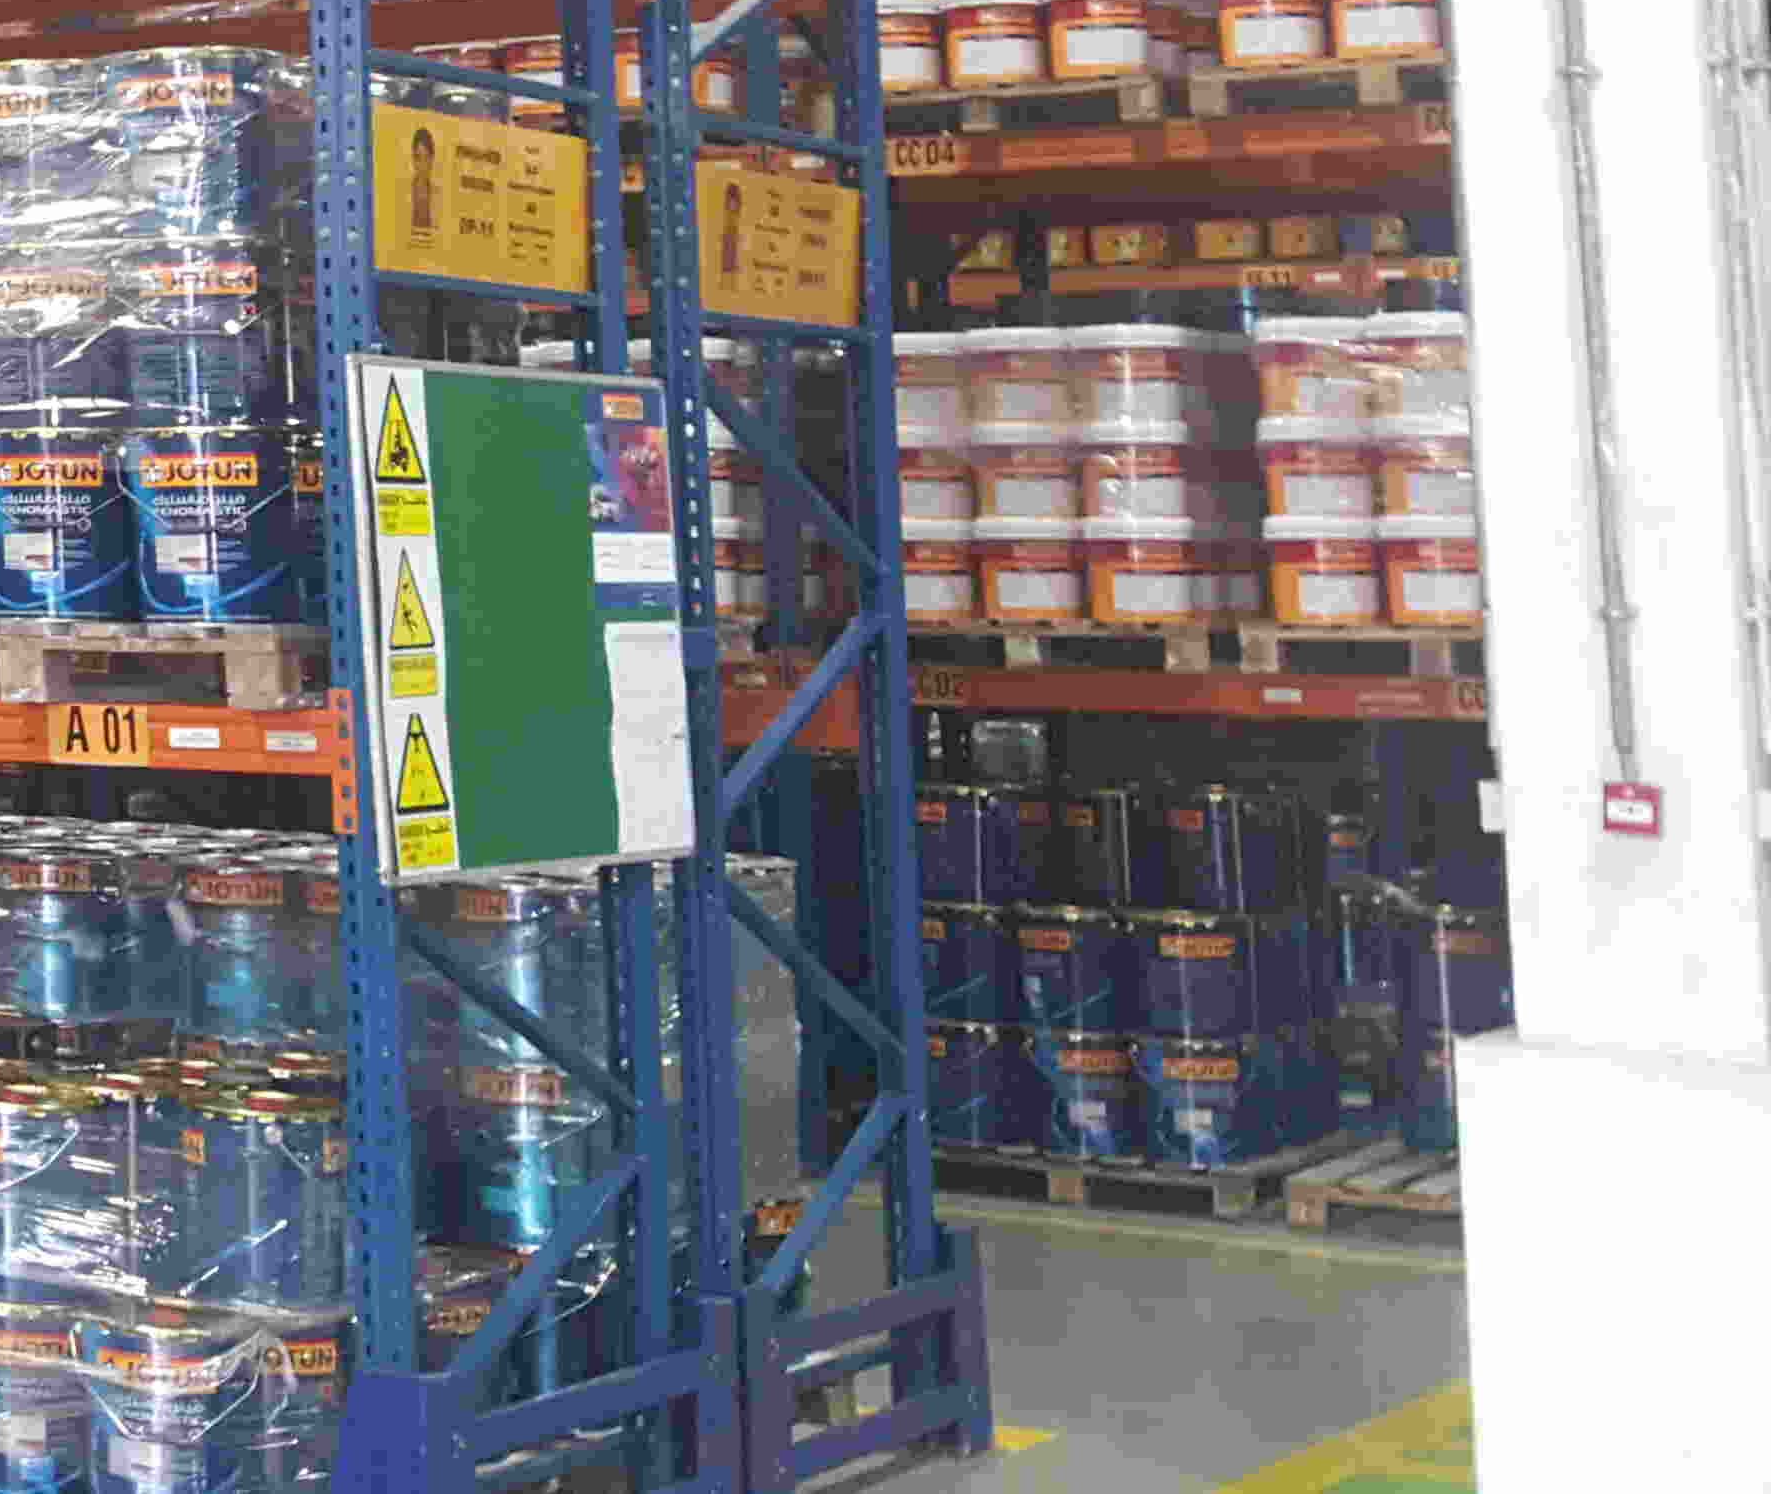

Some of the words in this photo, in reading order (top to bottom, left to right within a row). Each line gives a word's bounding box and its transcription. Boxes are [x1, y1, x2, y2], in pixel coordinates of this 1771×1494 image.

[894, 141, 956, 171] CC04
[11, 459, 99, 484] JOTUN
[163, 459, 253, 483] JOTUN
[66, 709, 90, 754] A
[104, 707, 138, 755] 01
[264, 1347, 336, 1369] OTUN
